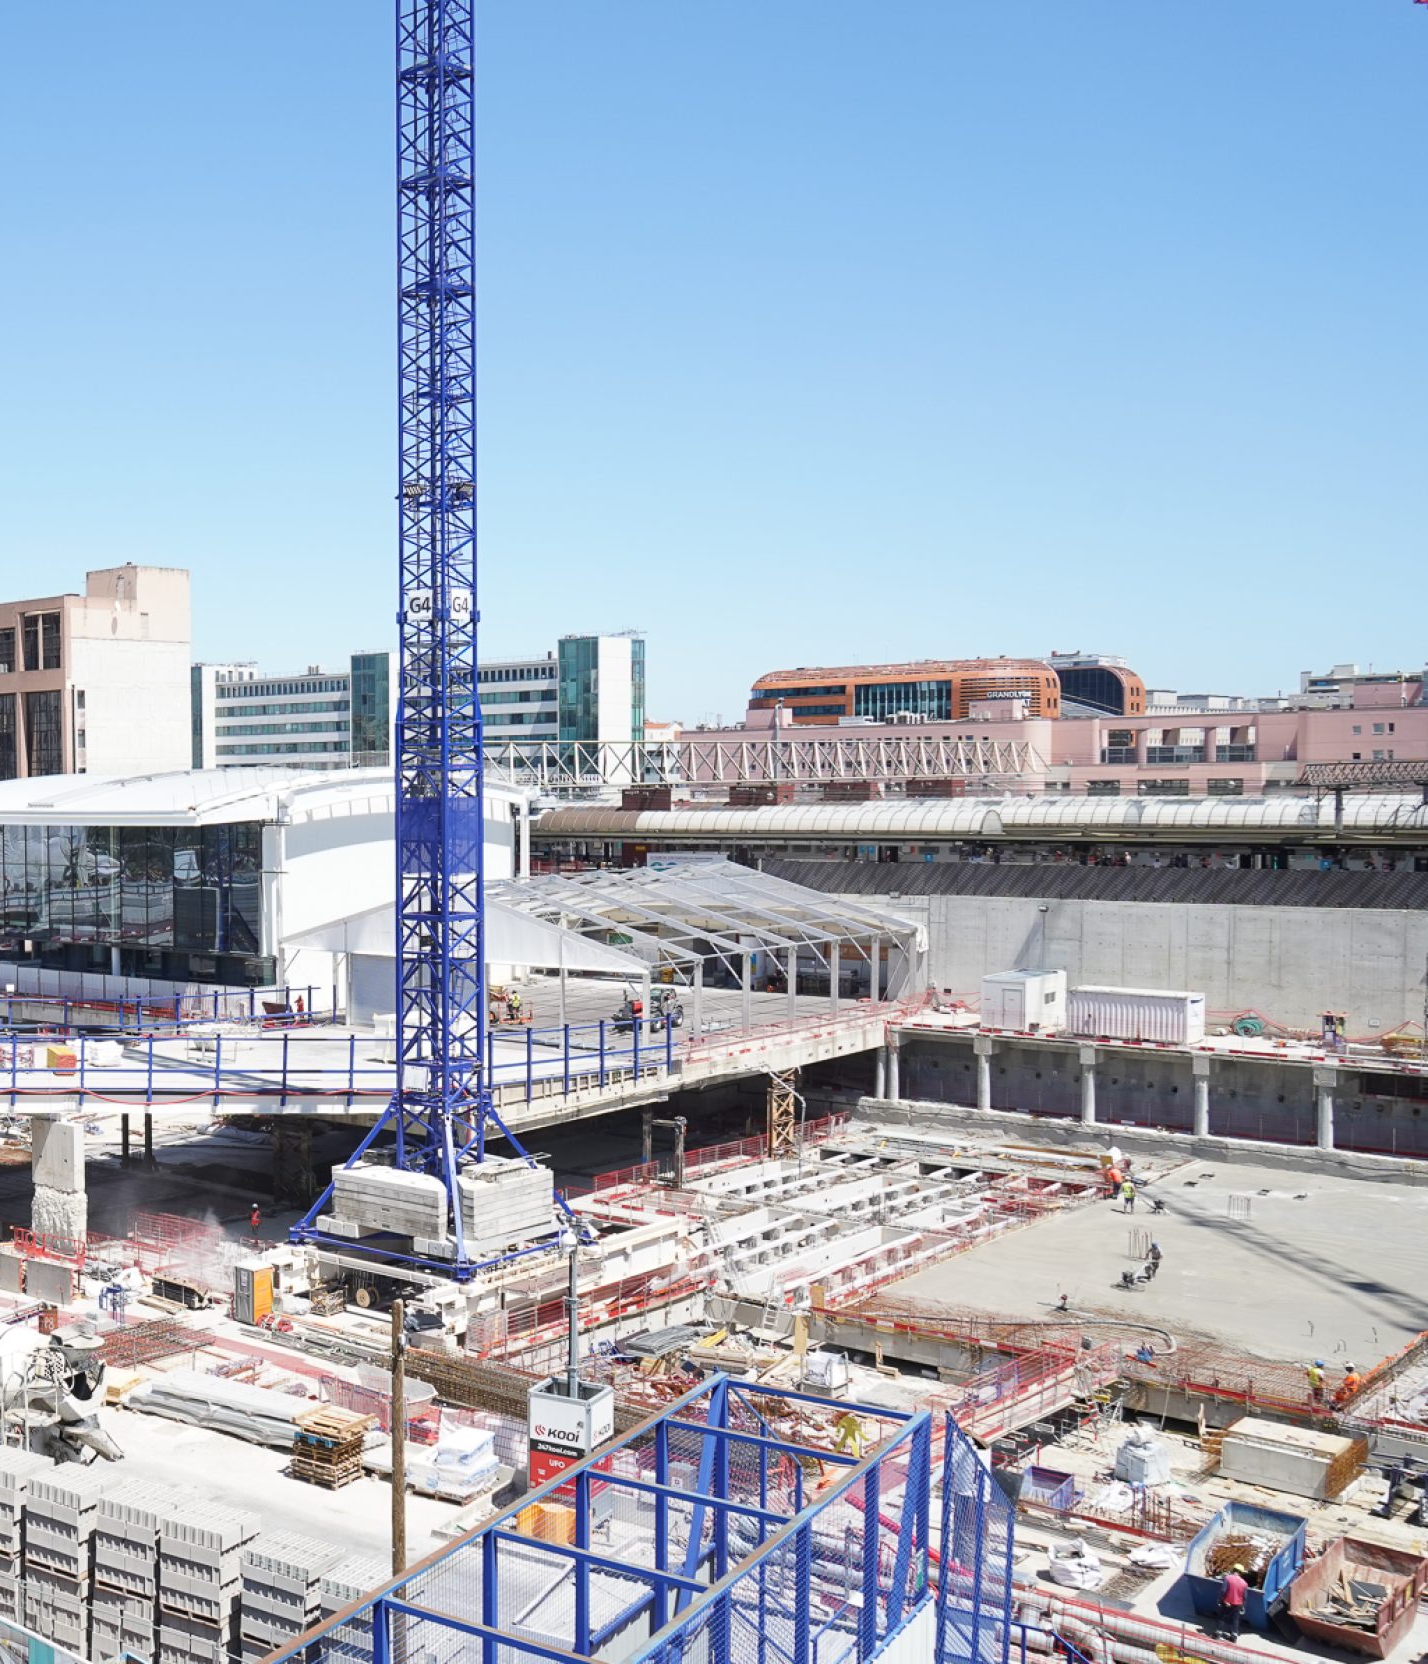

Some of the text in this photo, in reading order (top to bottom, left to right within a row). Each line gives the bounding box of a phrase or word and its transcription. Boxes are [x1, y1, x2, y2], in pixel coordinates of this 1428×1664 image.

[410, 597, 431, 613] G4
[452, 596, 469, 613] G4
[549, 1459, 566, 1468] UFO
